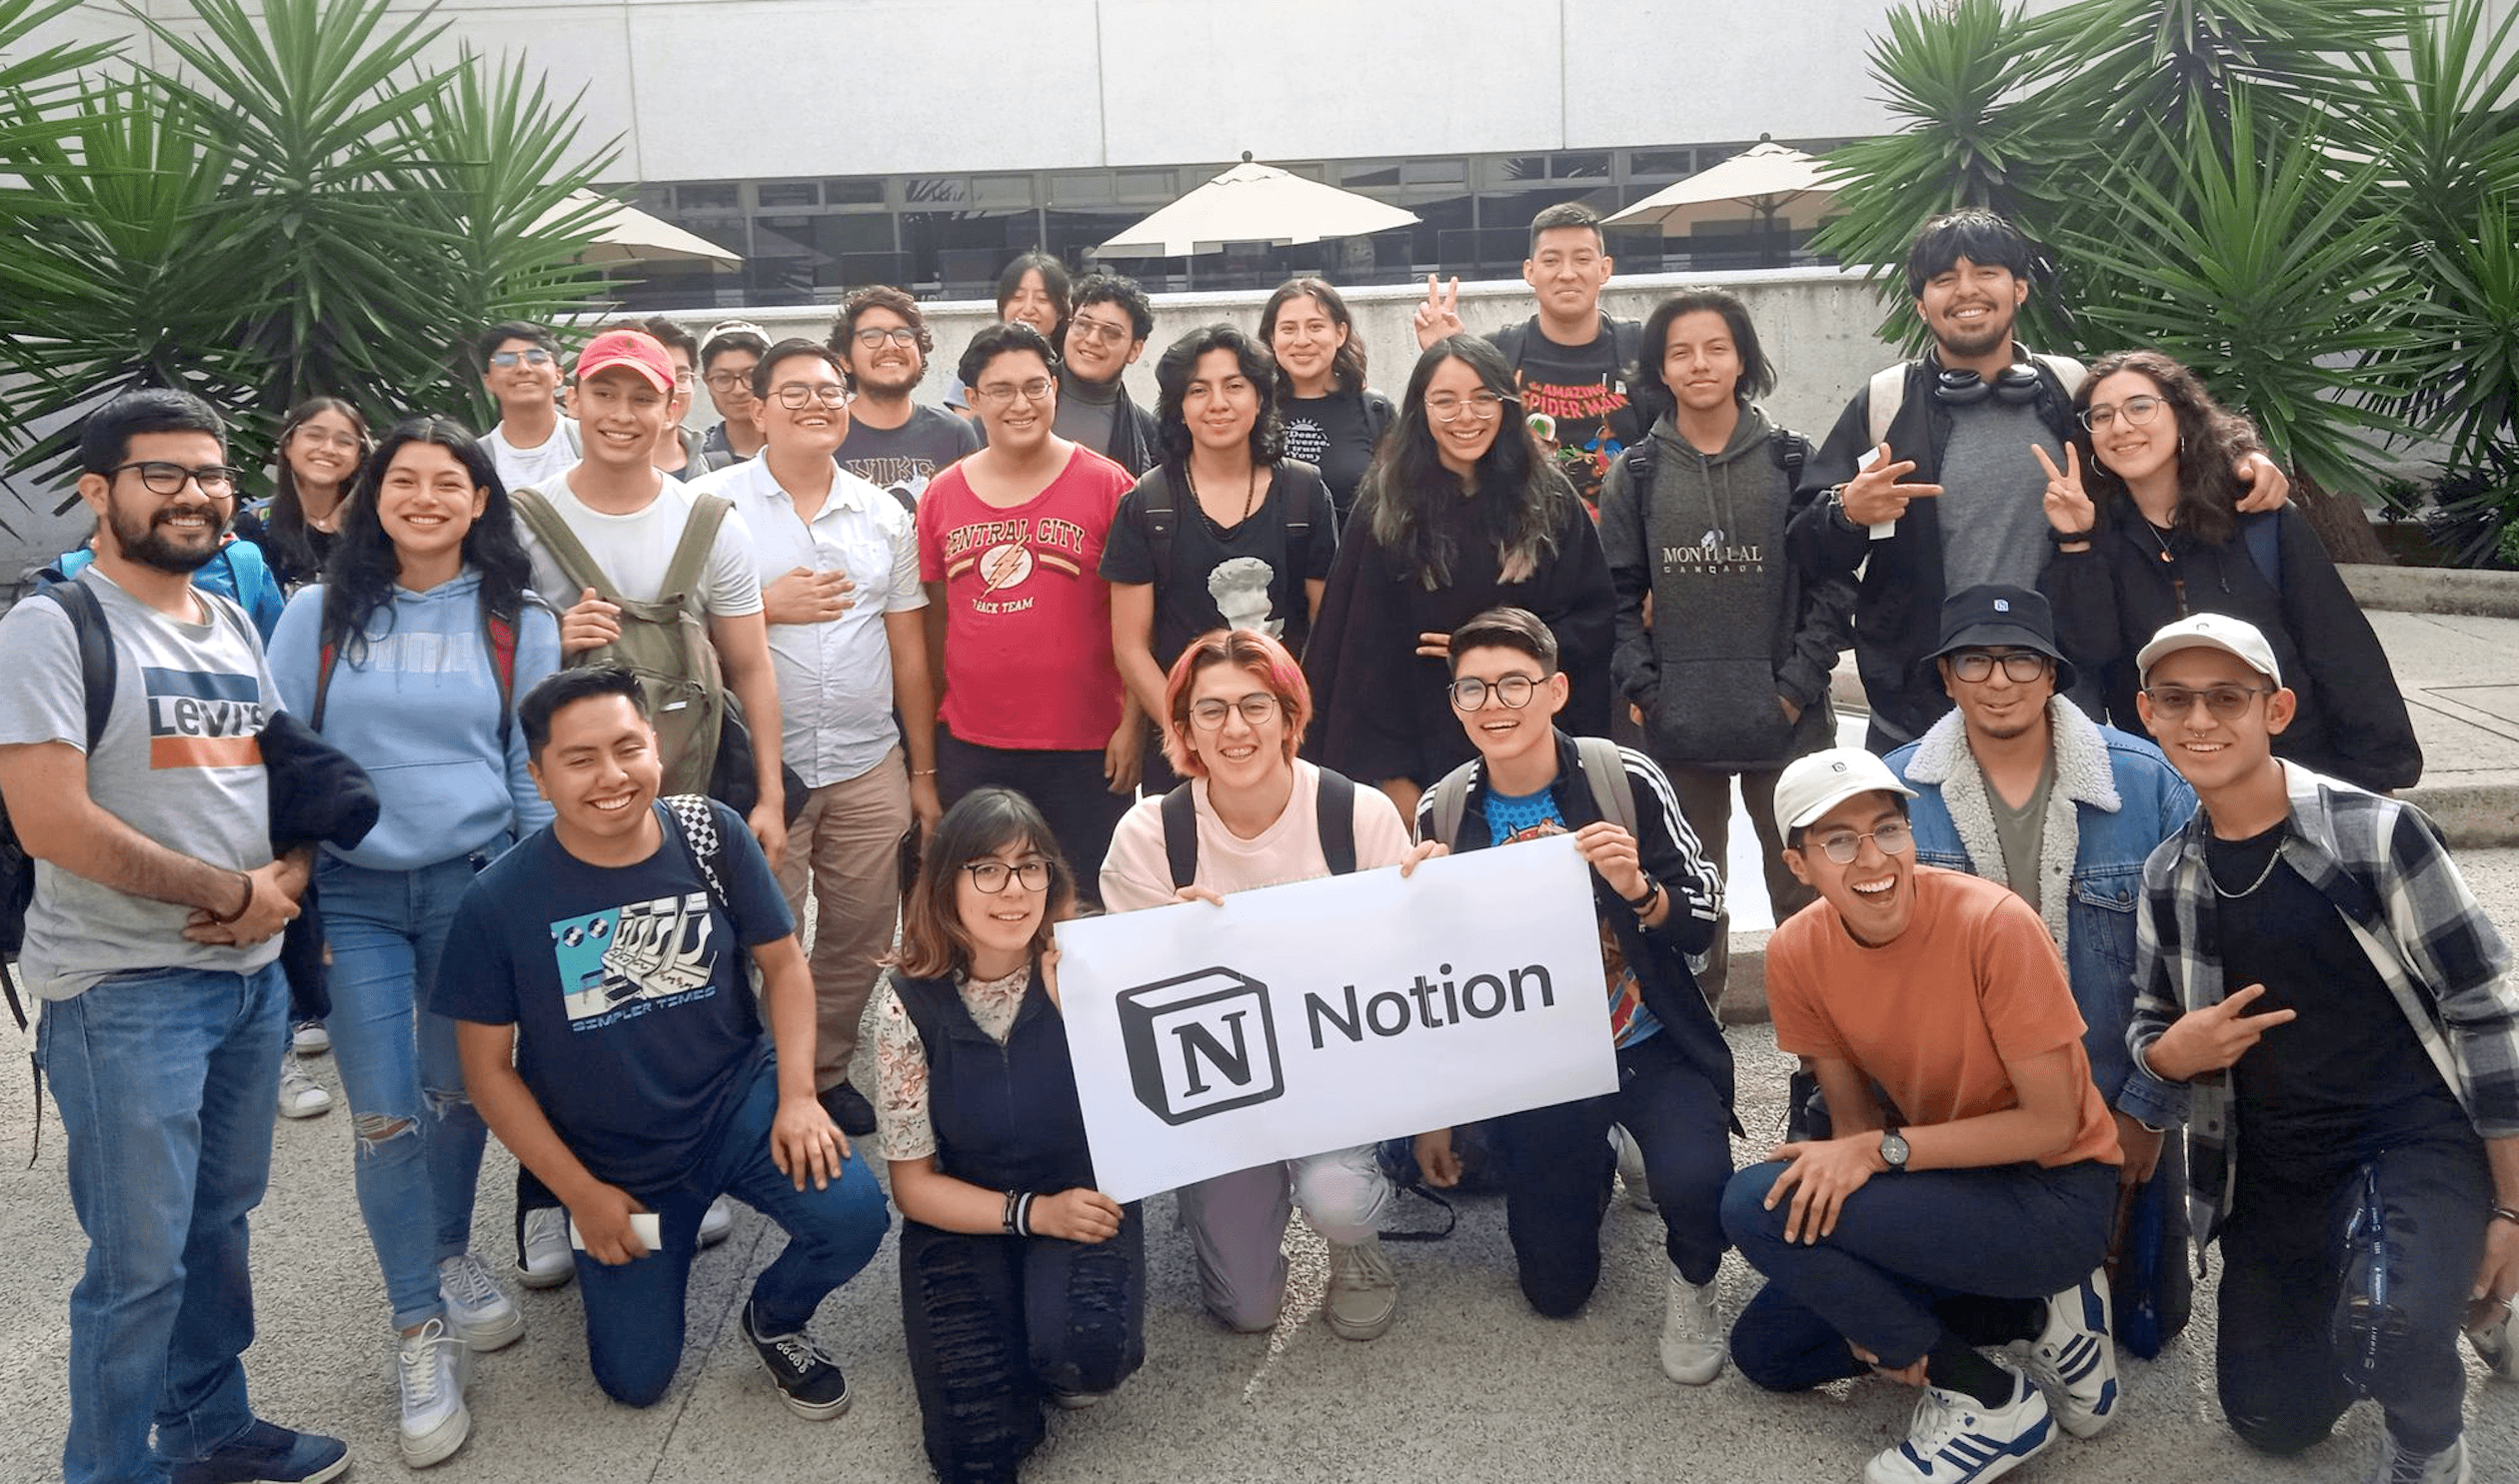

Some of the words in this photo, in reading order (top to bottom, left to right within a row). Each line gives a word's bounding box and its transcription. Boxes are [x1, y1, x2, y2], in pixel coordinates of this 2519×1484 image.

[1542, 384, 1607, 399] AMAZING
[1037, 518, 1086, 555] CITY
[1001, 597, 1034, 613] TEAM
[572, 1002, 652, 1031] SIMPLER
[657, 985, 717, 1009] TIMES
[1171, 1010, 1252, 1098] N
[1303, 962, 1555, 1049] Notion
